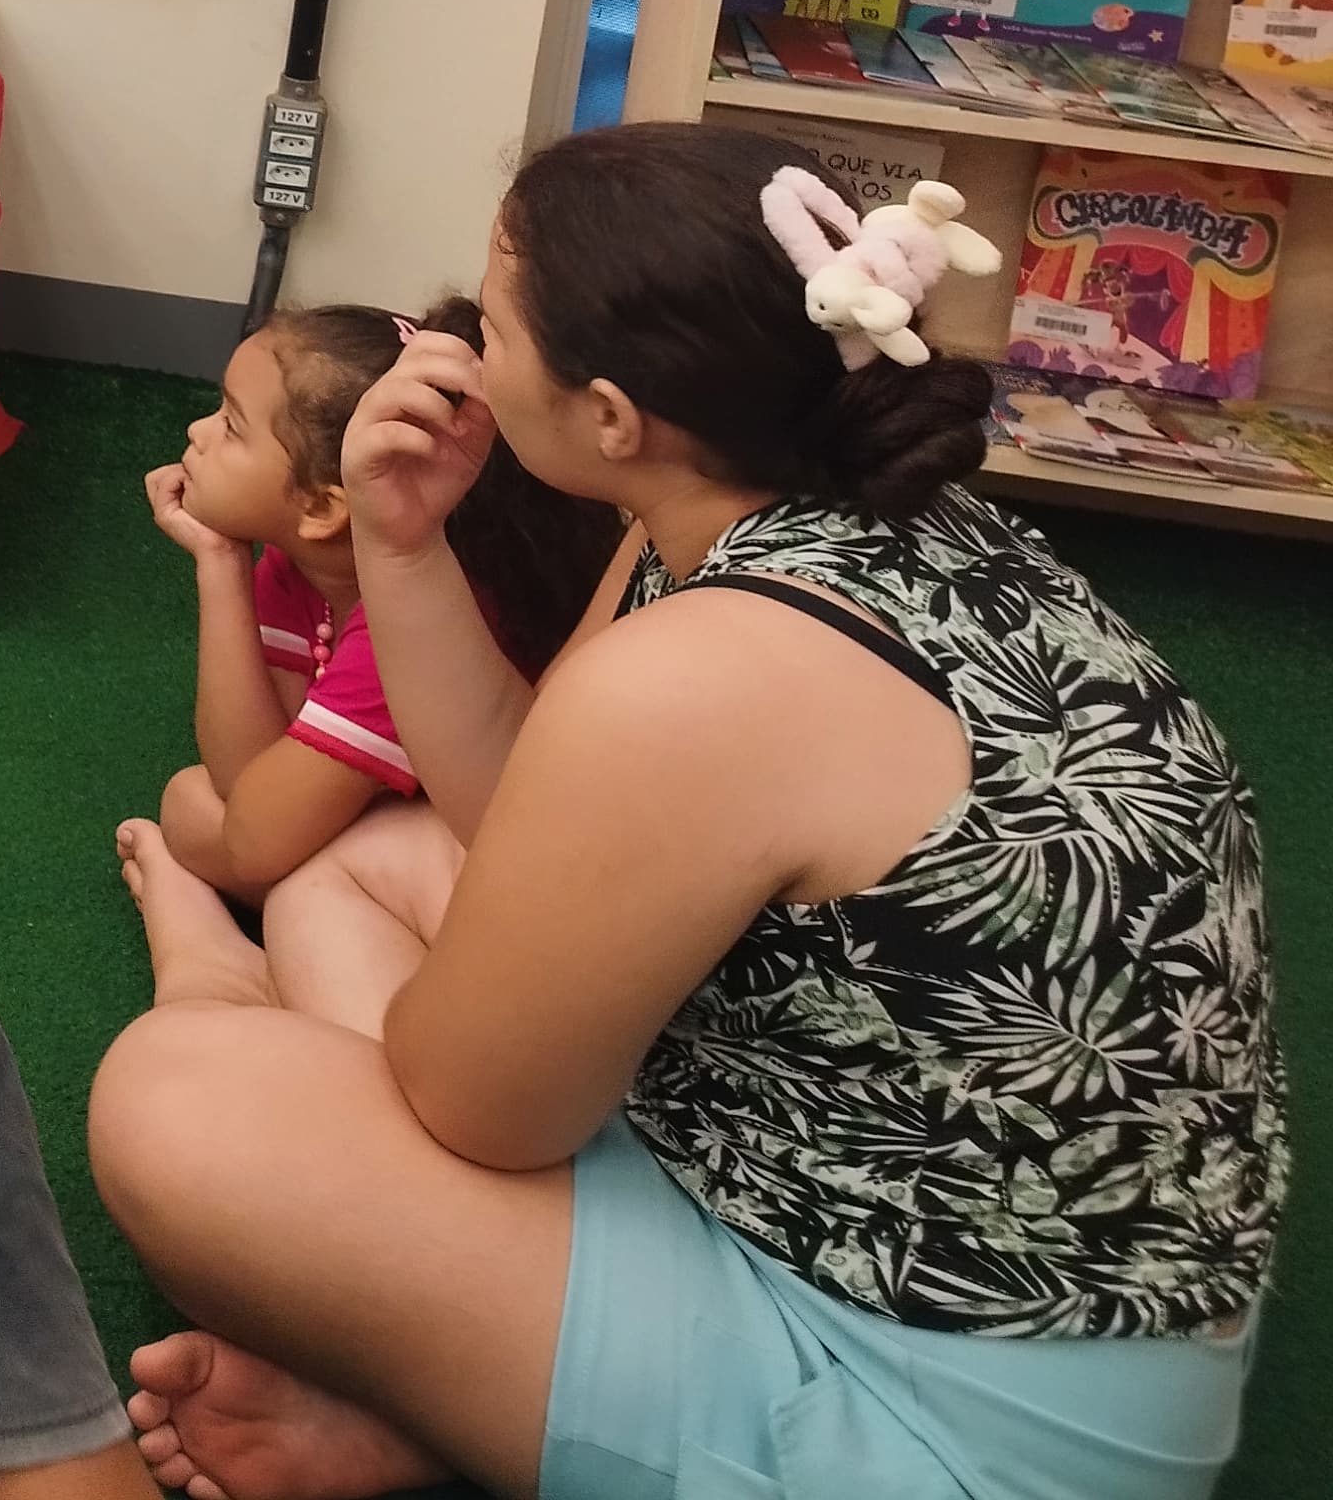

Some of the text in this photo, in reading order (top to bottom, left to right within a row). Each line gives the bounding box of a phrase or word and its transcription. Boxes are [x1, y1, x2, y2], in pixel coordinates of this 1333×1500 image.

[281, 111, 303, 122] 127
[827, 153, 874, 176] QUE
[269, 191, 290, 202] 127
[1054, 191, 1253, 259] CIRCOLÂNDIA
